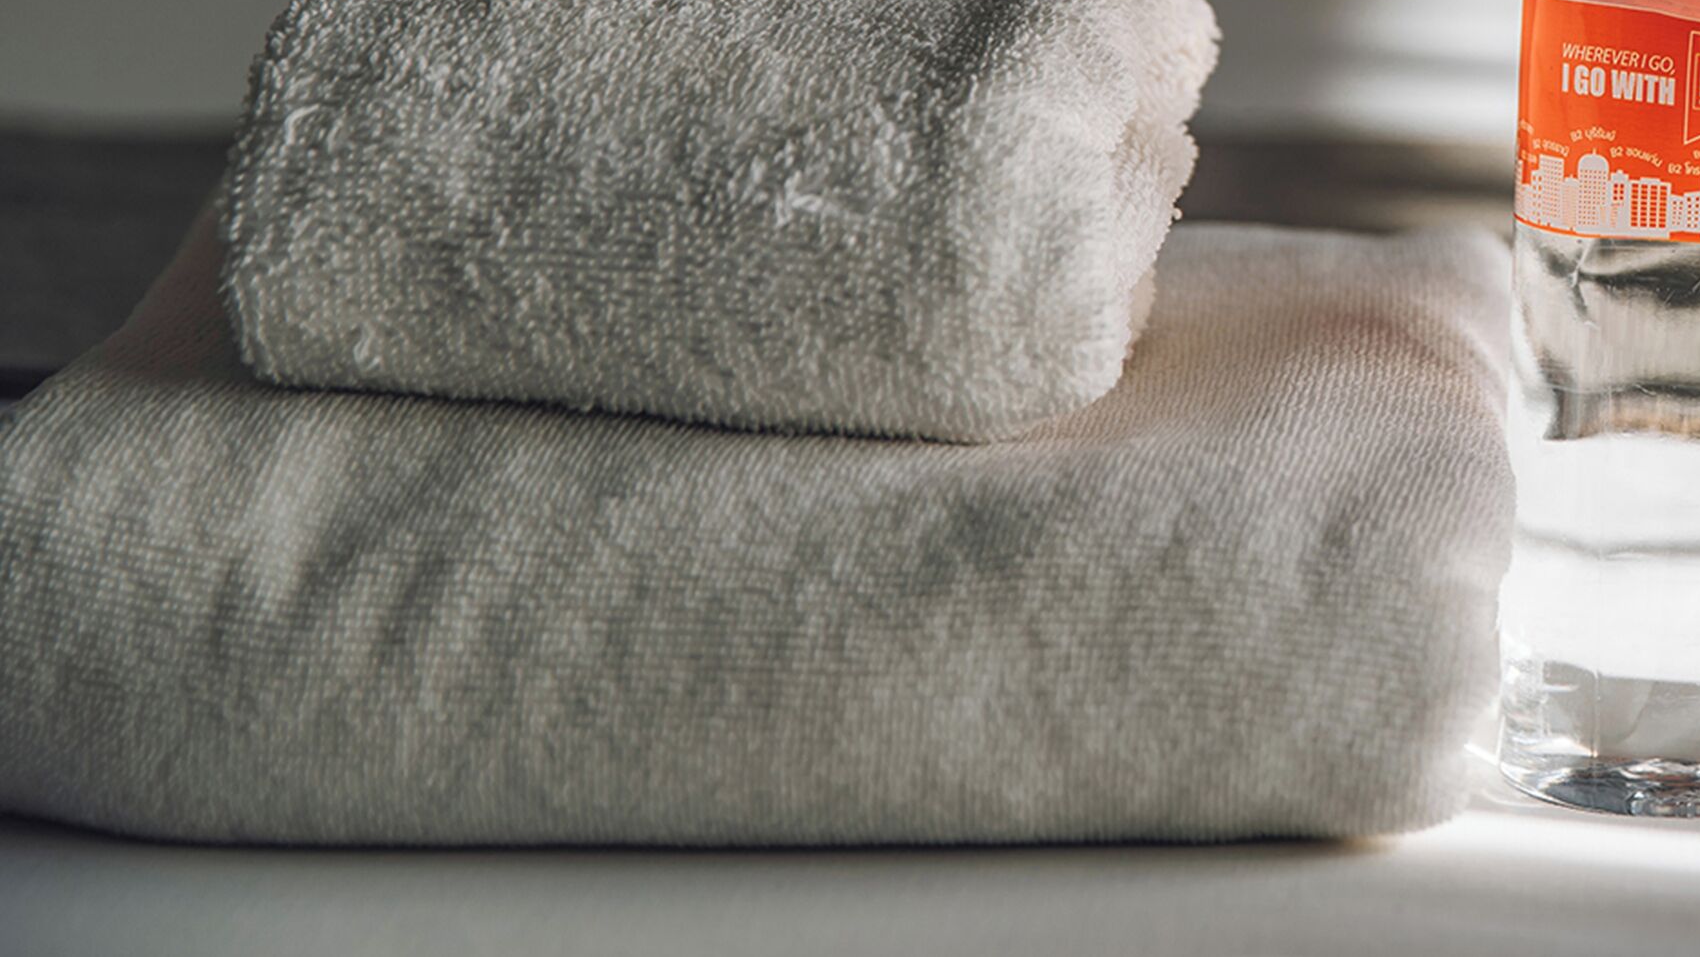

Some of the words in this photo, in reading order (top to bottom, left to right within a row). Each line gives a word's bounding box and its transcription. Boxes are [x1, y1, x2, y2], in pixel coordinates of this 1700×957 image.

[1562, 42, 1640, 68] WHEREVER
[1641, 53, 1647, 69] I
[1648, 55, 1675, 75] GO,
[1561, 62, 1570, 93] I
[1574, 64, 1606, 97] GO
[1611, 69, 1676, 106] WITH
